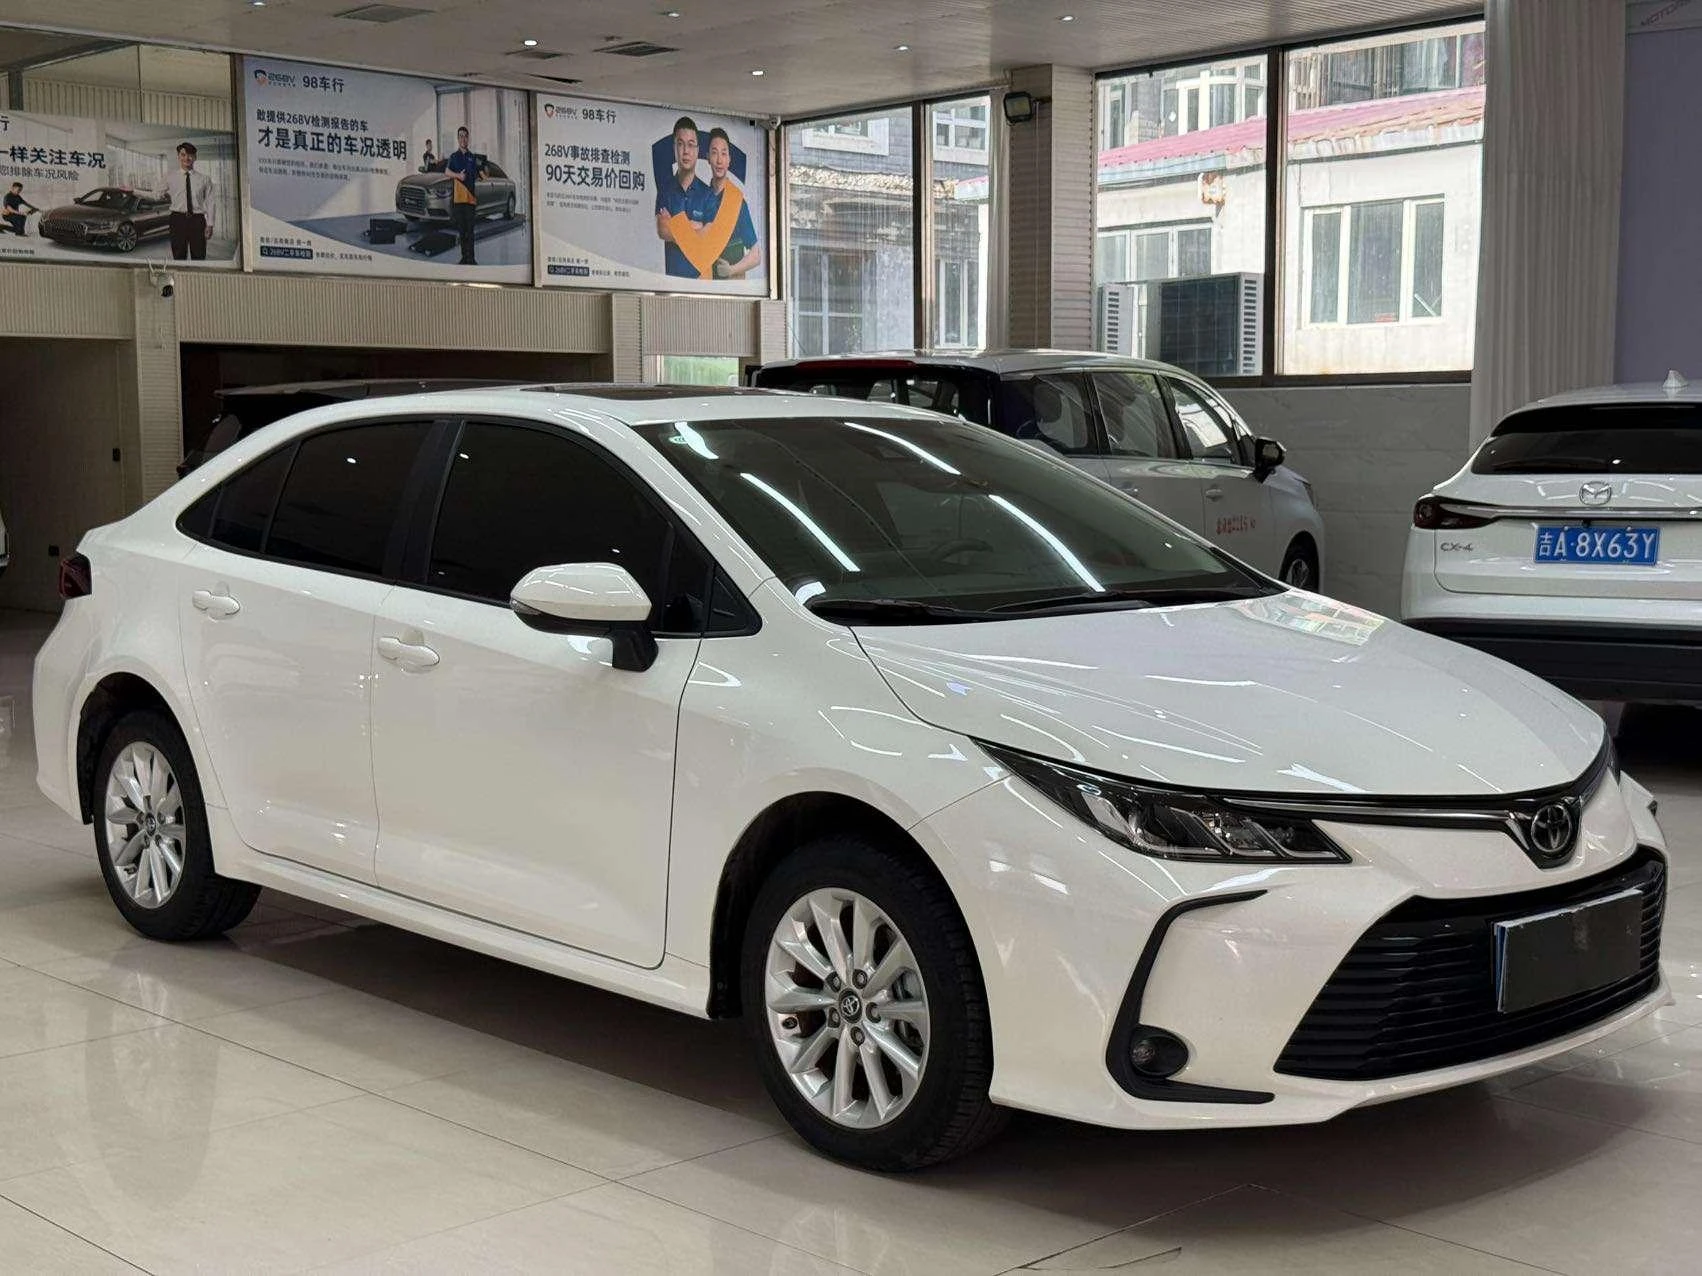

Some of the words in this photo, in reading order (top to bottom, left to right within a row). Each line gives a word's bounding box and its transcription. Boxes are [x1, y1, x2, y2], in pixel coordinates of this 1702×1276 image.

[302, 75, 345, 93] 98车行
[256, 108, 369, 132] 敢提供268V检测报告的车
[582, 109, 617, 124] 98车行
[257, 127, 408, 160] 才是真正的车况透明
[544, 143, 631, 165] 268V事故排查检测
[545, 164, 646, 191] 90天交易价回购
[1440, 541, 1474, 553] CX-4
